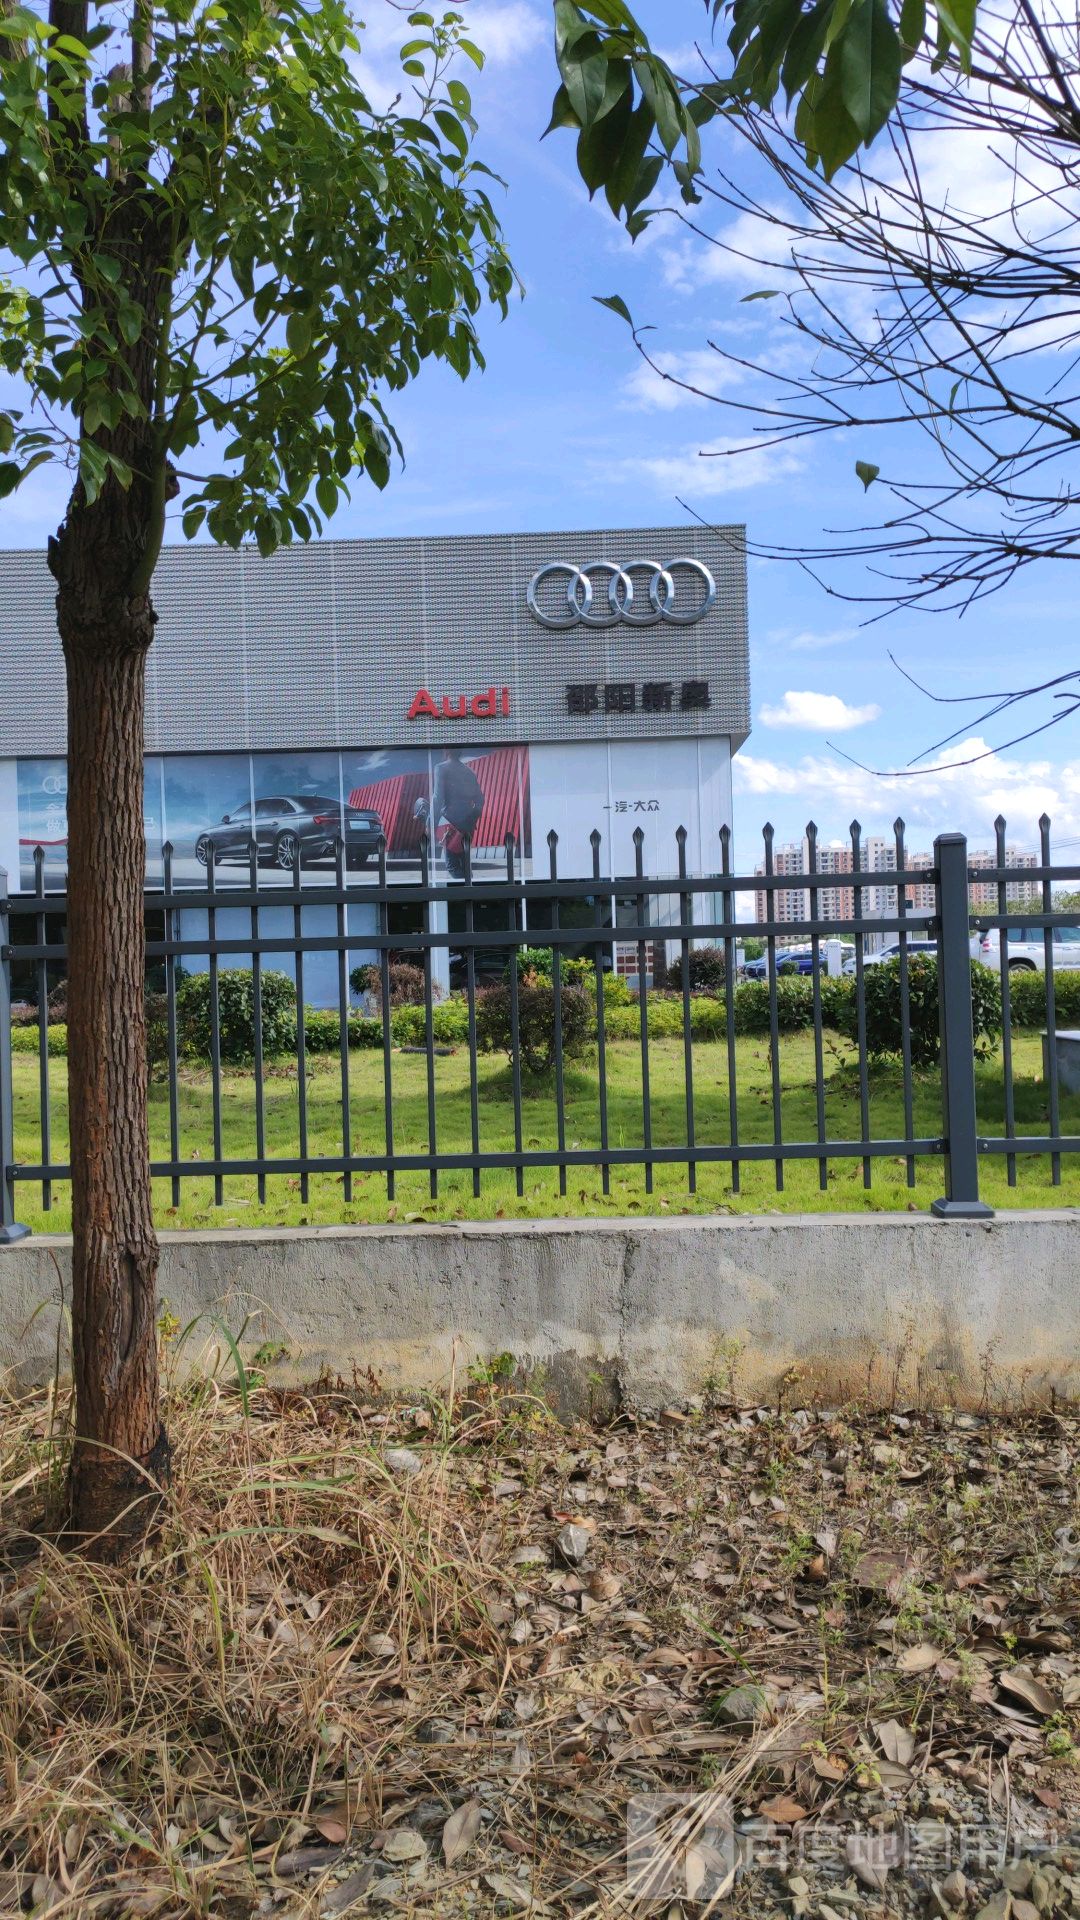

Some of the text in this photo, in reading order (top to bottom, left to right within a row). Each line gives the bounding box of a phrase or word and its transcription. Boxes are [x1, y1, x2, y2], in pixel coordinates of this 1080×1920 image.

[407, 687, 510, 719] Audi
[603, 799, 660, 812] 一汽-大众
